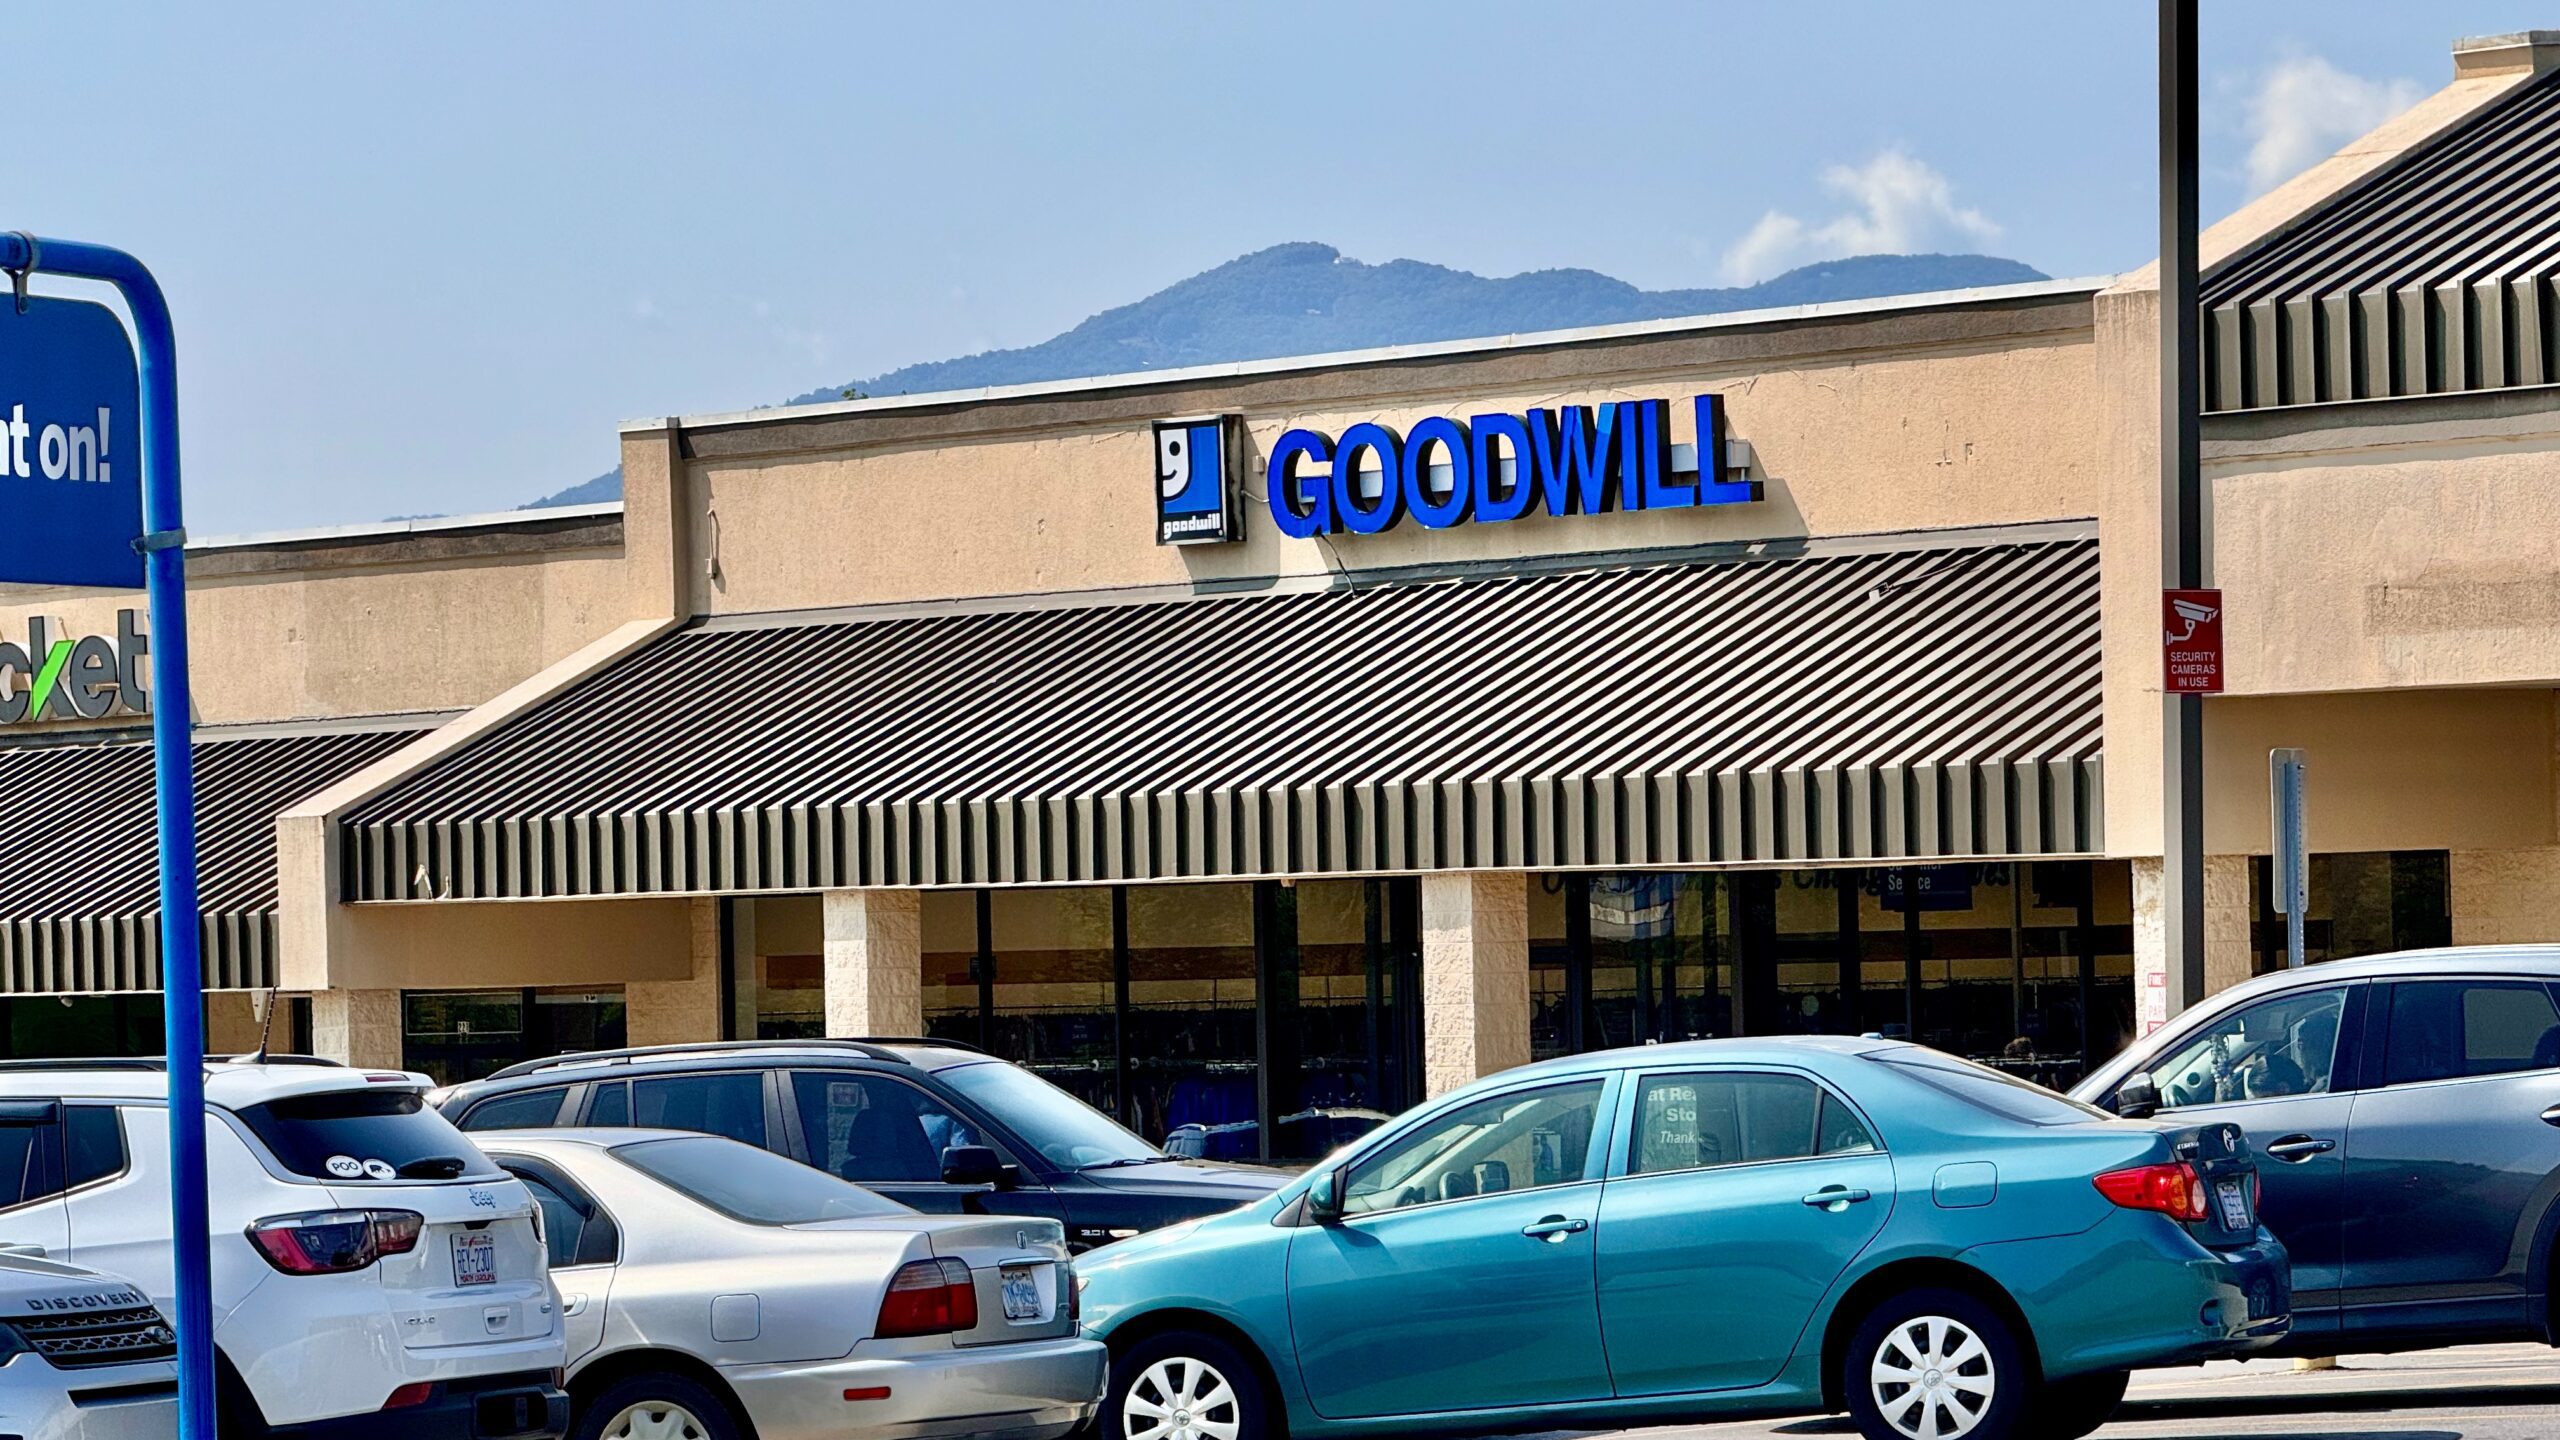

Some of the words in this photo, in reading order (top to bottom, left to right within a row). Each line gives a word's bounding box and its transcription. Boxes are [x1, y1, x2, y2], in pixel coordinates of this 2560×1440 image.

[40, 407, 110, 482] on!
[1268, 394, 1753, 538] GOODWILL
[1163, 513, 1221, 540] goodwill
[2170, 652, 2216, 662] SECURITY
[2171, 664, 2216, 674] CAMERAS
[2178, 677, 2187, 687] IN
[2189, 677, 2209, 687] USE
[1660, 1130, 1696, 1144] Thank
[331, 1161, 359, 1172] POO
[26, 1291, 141, 1311] DISCOVERY
